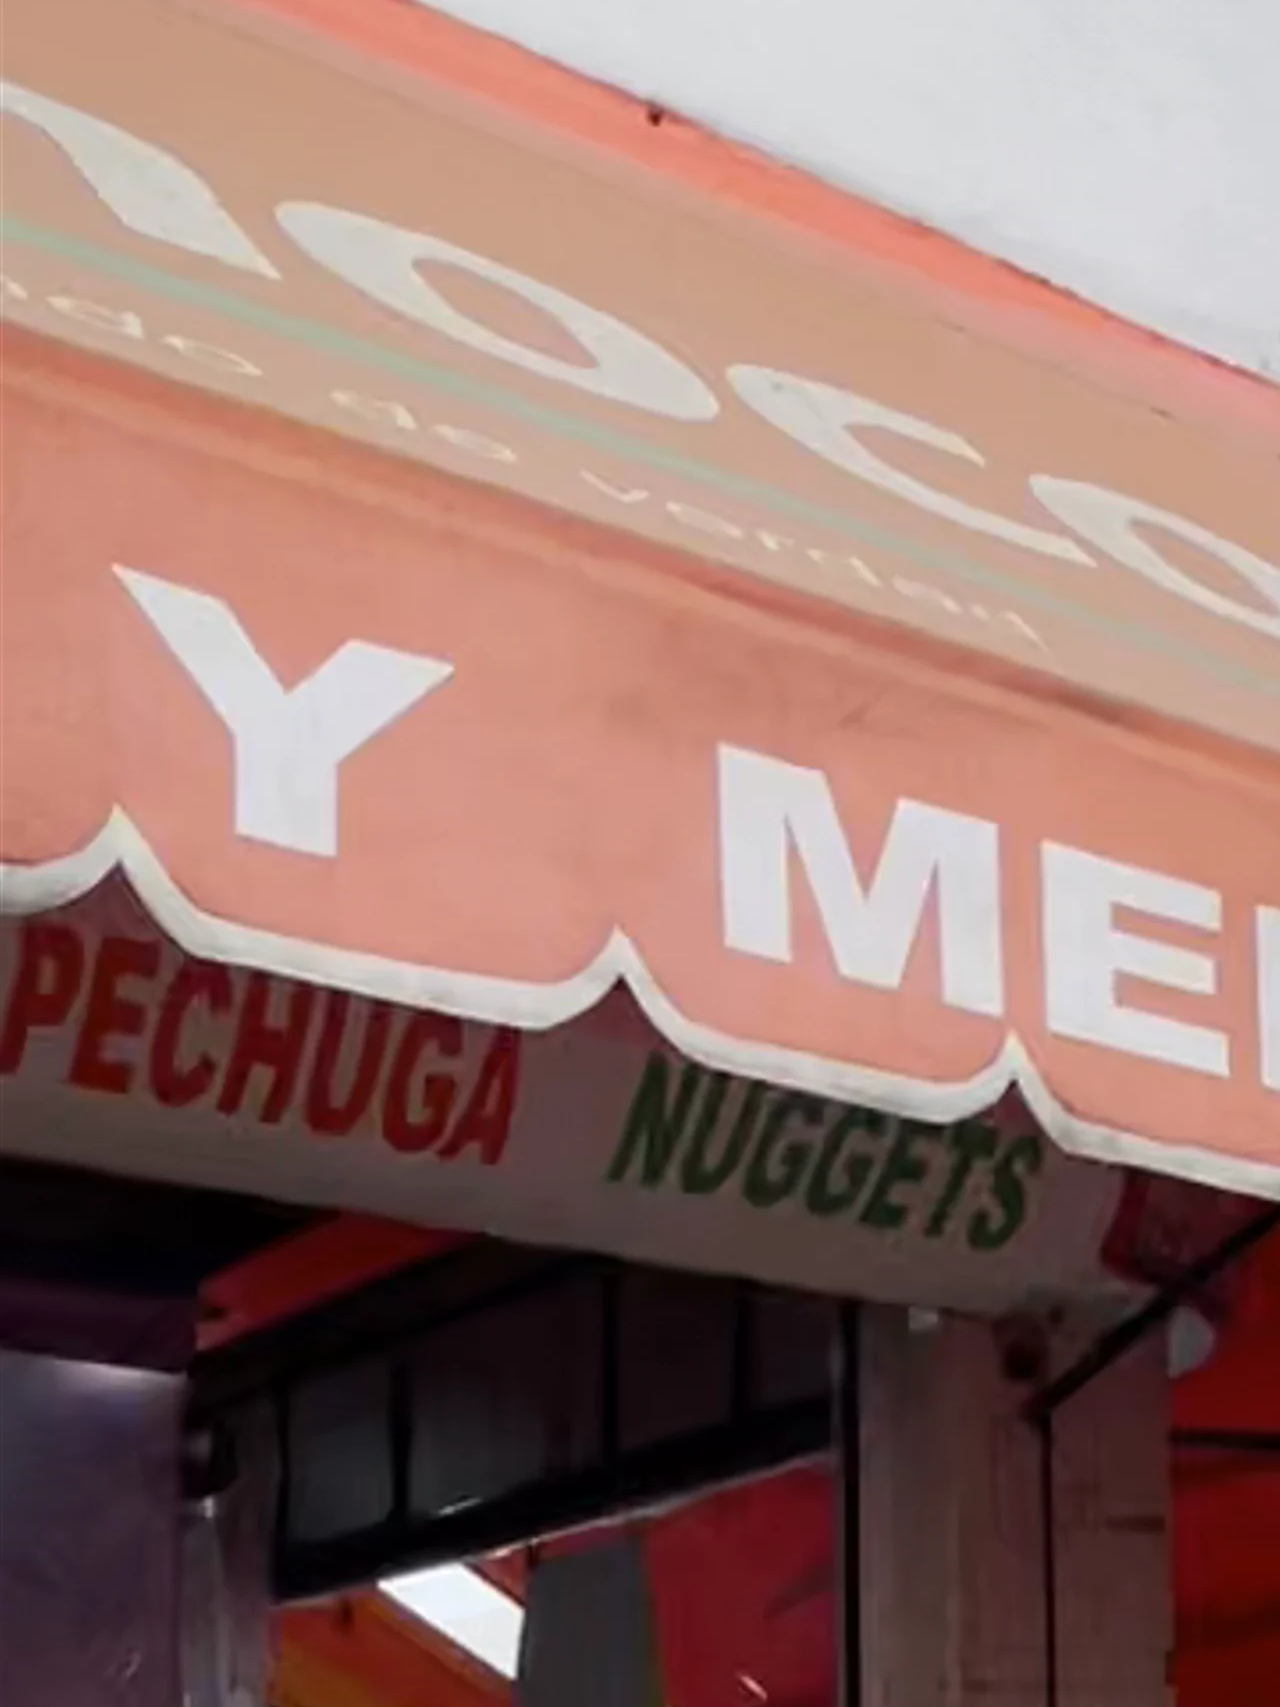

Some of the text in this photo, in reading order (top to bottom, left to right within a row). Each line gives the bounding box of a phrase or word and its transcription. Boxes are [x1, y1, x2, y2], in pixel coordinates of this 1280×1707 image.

[112, 561, 456, 859] Y
[0, 923, 1045, 1253] PECHUGA NUGGETS
